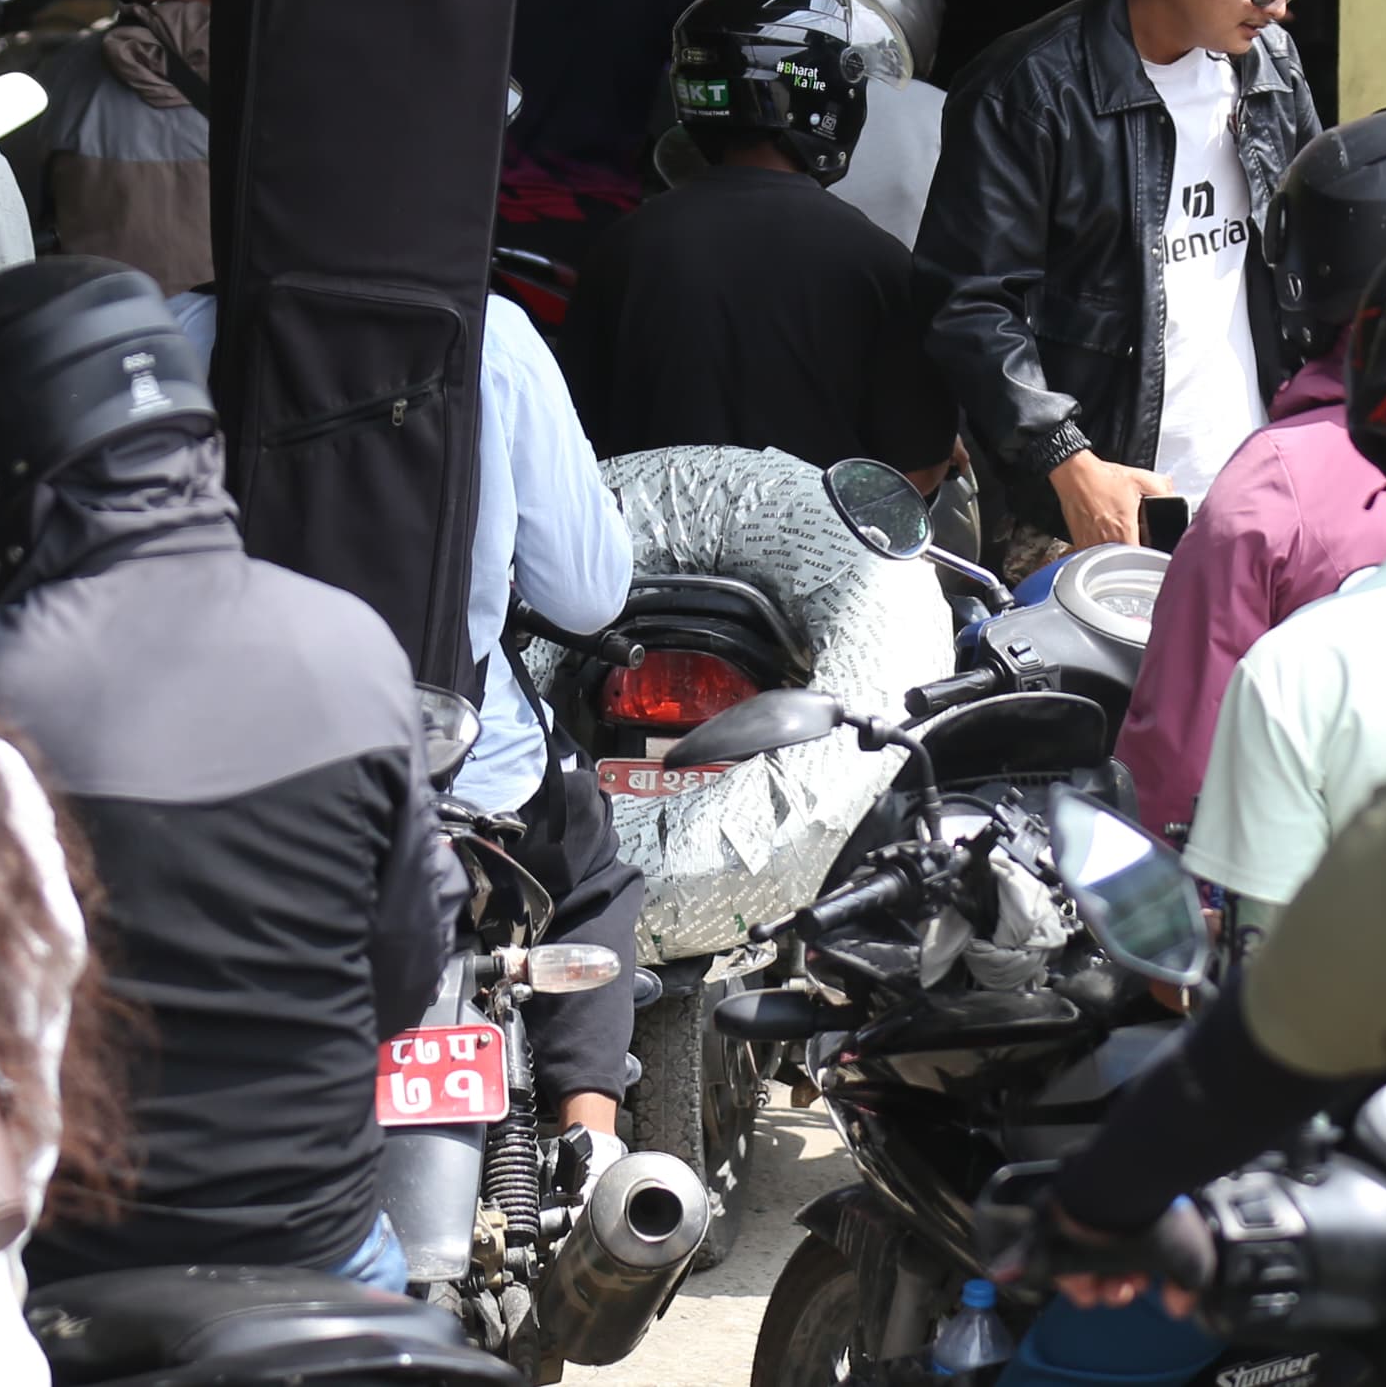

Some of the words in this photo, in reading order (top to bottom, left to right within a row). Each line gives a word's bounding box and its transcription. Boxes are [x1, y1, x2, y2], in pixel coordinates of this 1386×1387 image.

[776, 61, 819, 79] #Bharat
[1163, 217, 1247, 265] lencia
[797, 543, 825, 556] MAXXIS
[829, 543, 859, 558] MAXXIS
[803, 558, 833, 573] MAXXIS
[628, 769, 659, 791] बा
